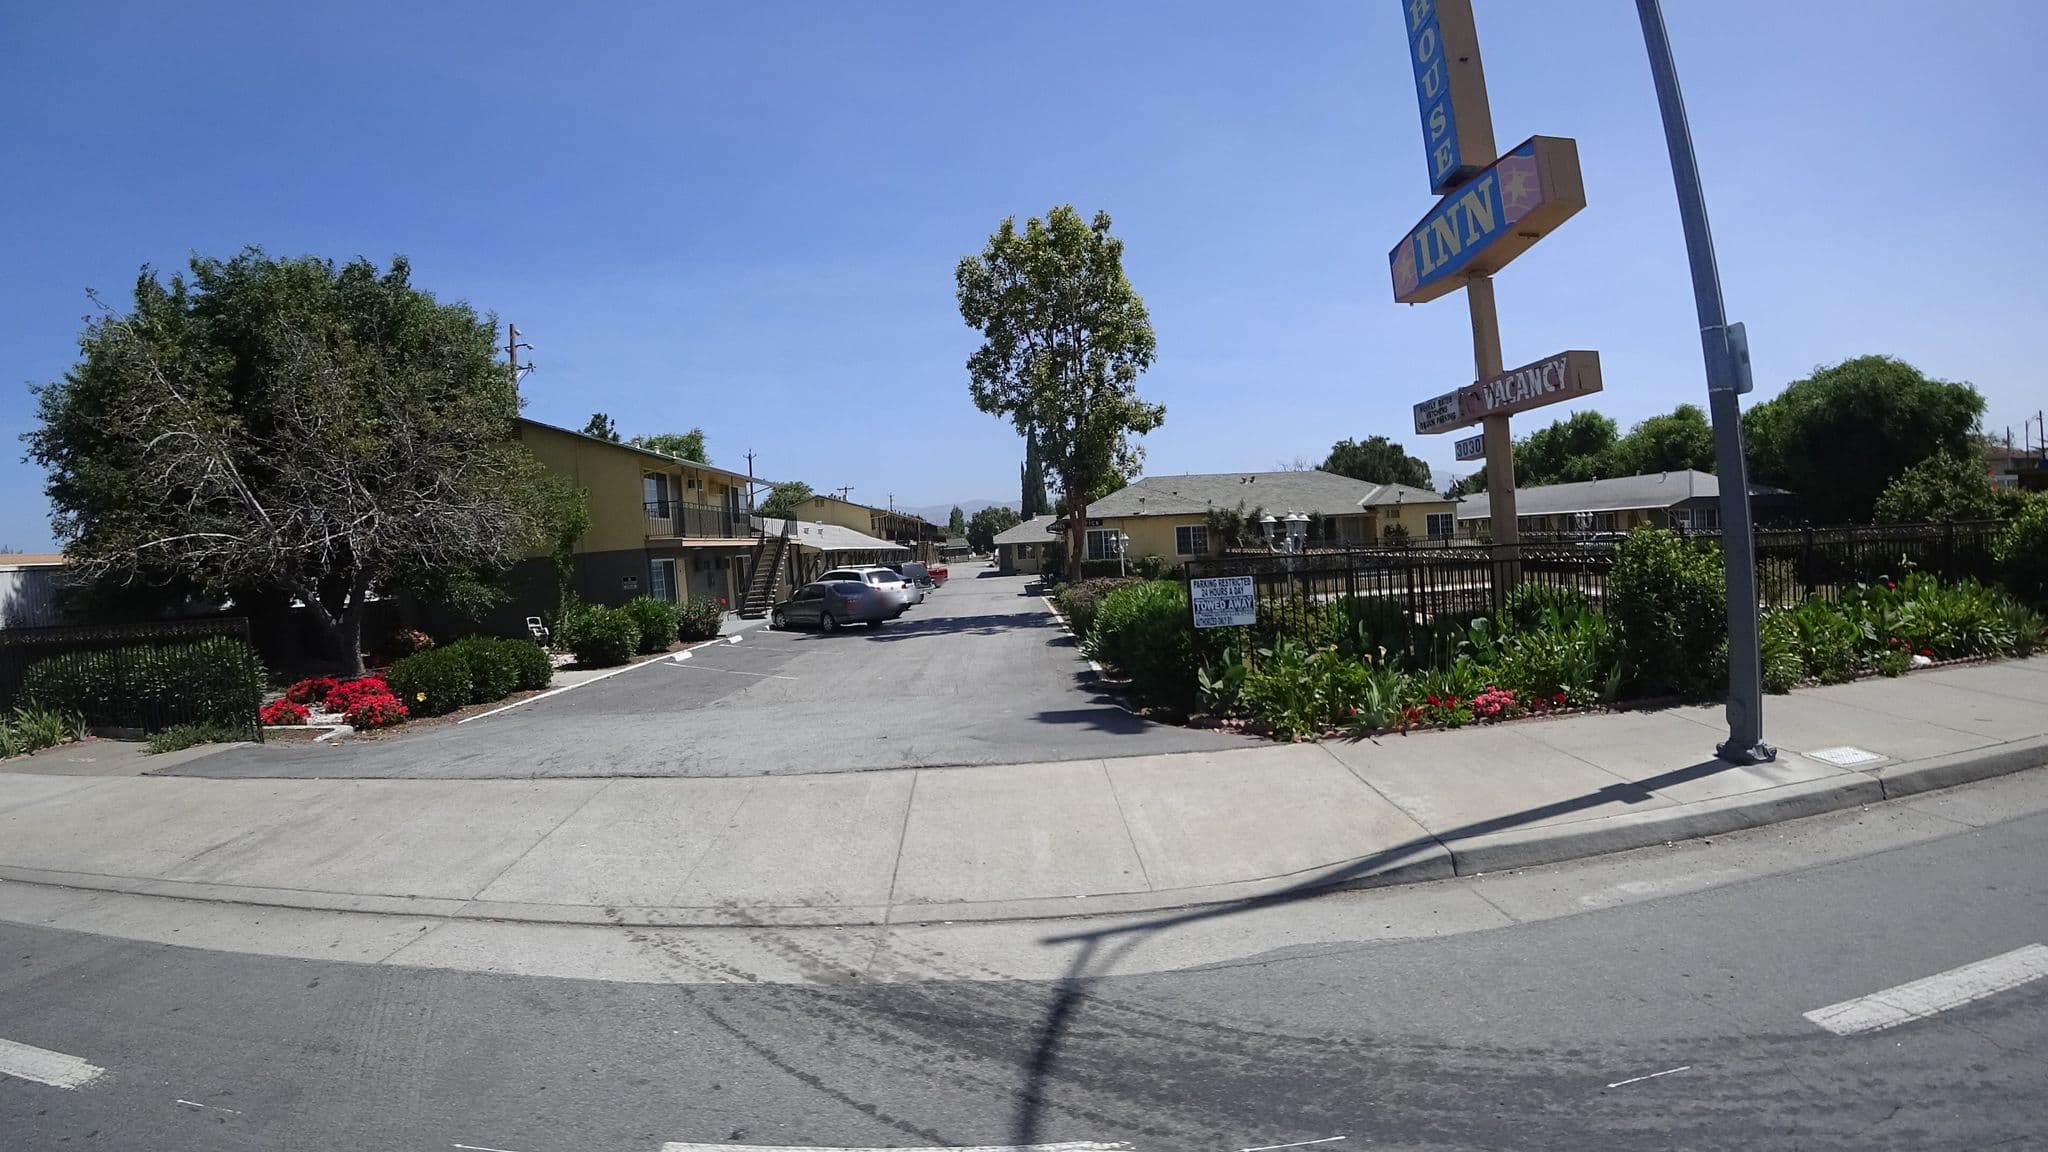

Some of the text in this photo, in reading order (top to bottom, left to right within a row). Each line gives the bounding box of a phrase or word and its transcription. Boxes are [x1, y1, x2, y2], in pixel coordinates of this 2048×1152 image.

[1416, 176, 1496, 278] INN
[1483, 357, 1567, 410] VACANCY
[1456, 438, 1482, 458] 3030
[1193, 577, 1251, 589] PARKING RESTRICTED
[1202, 588, 1209, 597] 24
[1209, 587, 1228, 597] HOURS
[1234, 586, 1244, 595] DAY
[1195, 598, 1252, 611] TOWED AWAY
